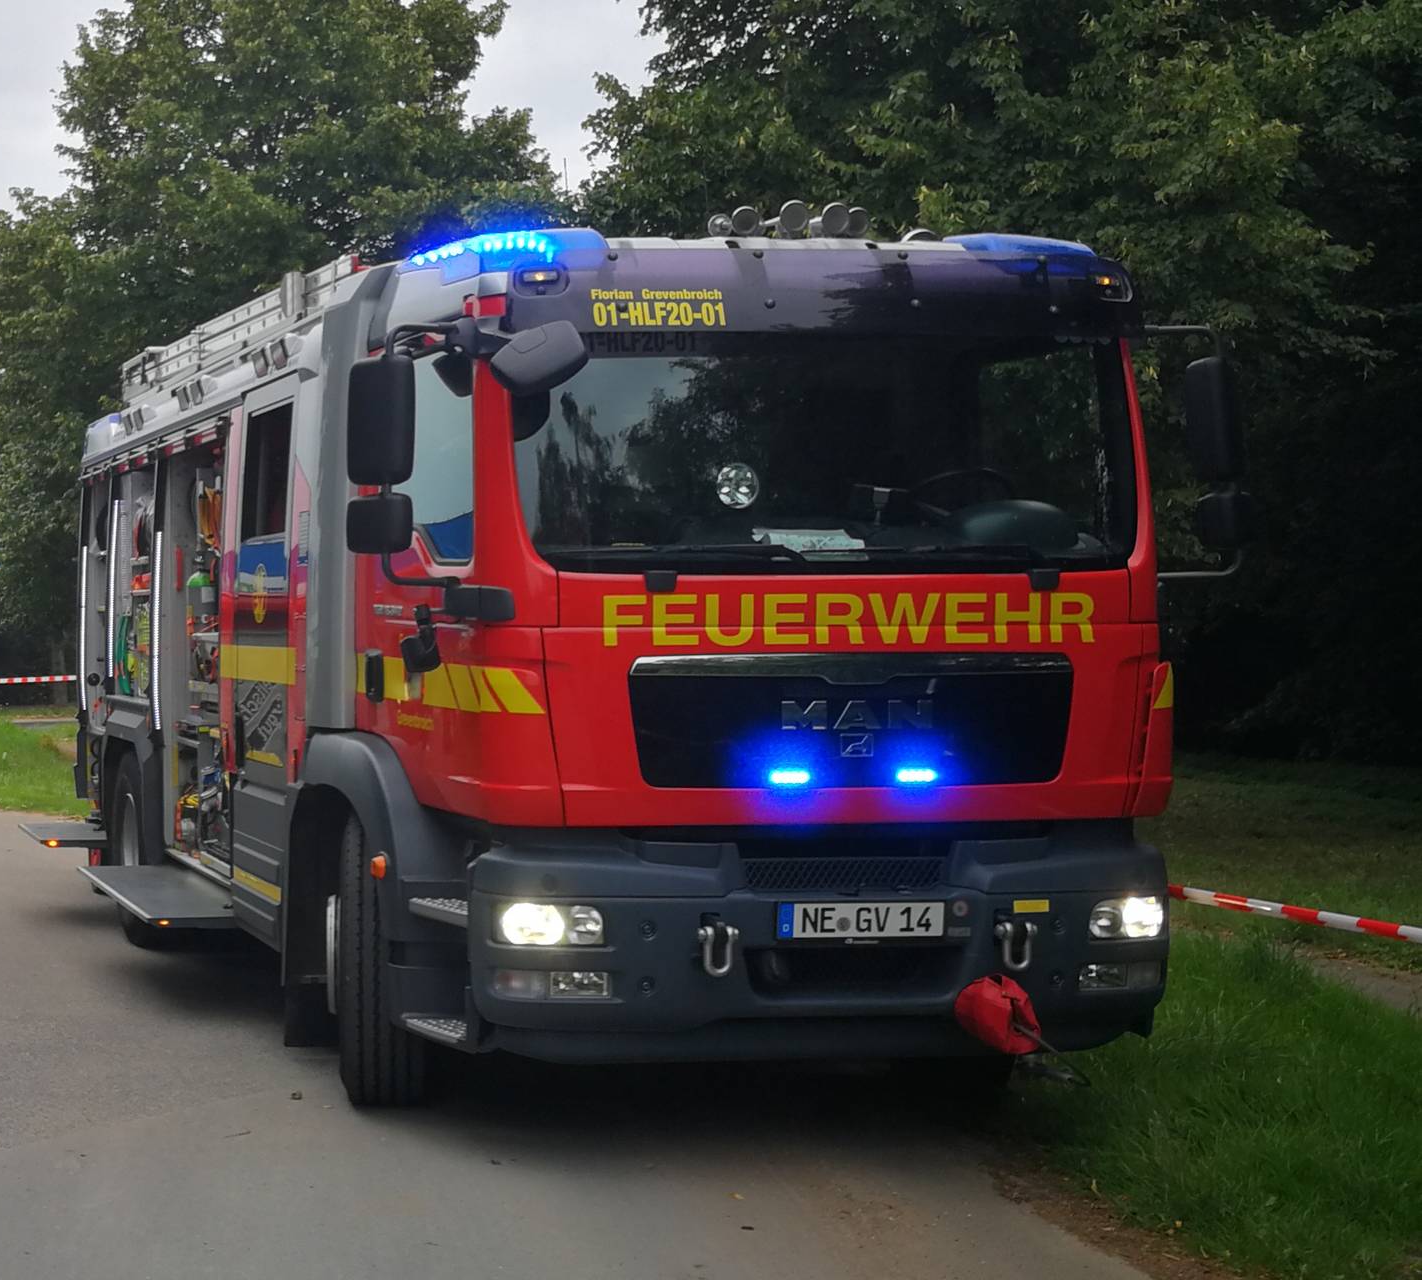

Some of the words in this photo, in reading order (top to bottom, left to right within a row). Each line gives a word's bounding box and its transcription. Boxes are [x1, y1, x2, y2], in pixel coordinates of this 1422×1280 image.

[590, 288, 633, 300] Florian
[641, 288, 722, 300] Grevenbroich
[592, 302, 726, 327] 01-HLF20-01
[602, 592, 1096, 647] FEUERWEHR
[781, 700, 934, 730] MAN
[801, 907, 836, 933] NE
[855, 907, 891, 933] GV
[899, 906, 932, 932] 14
